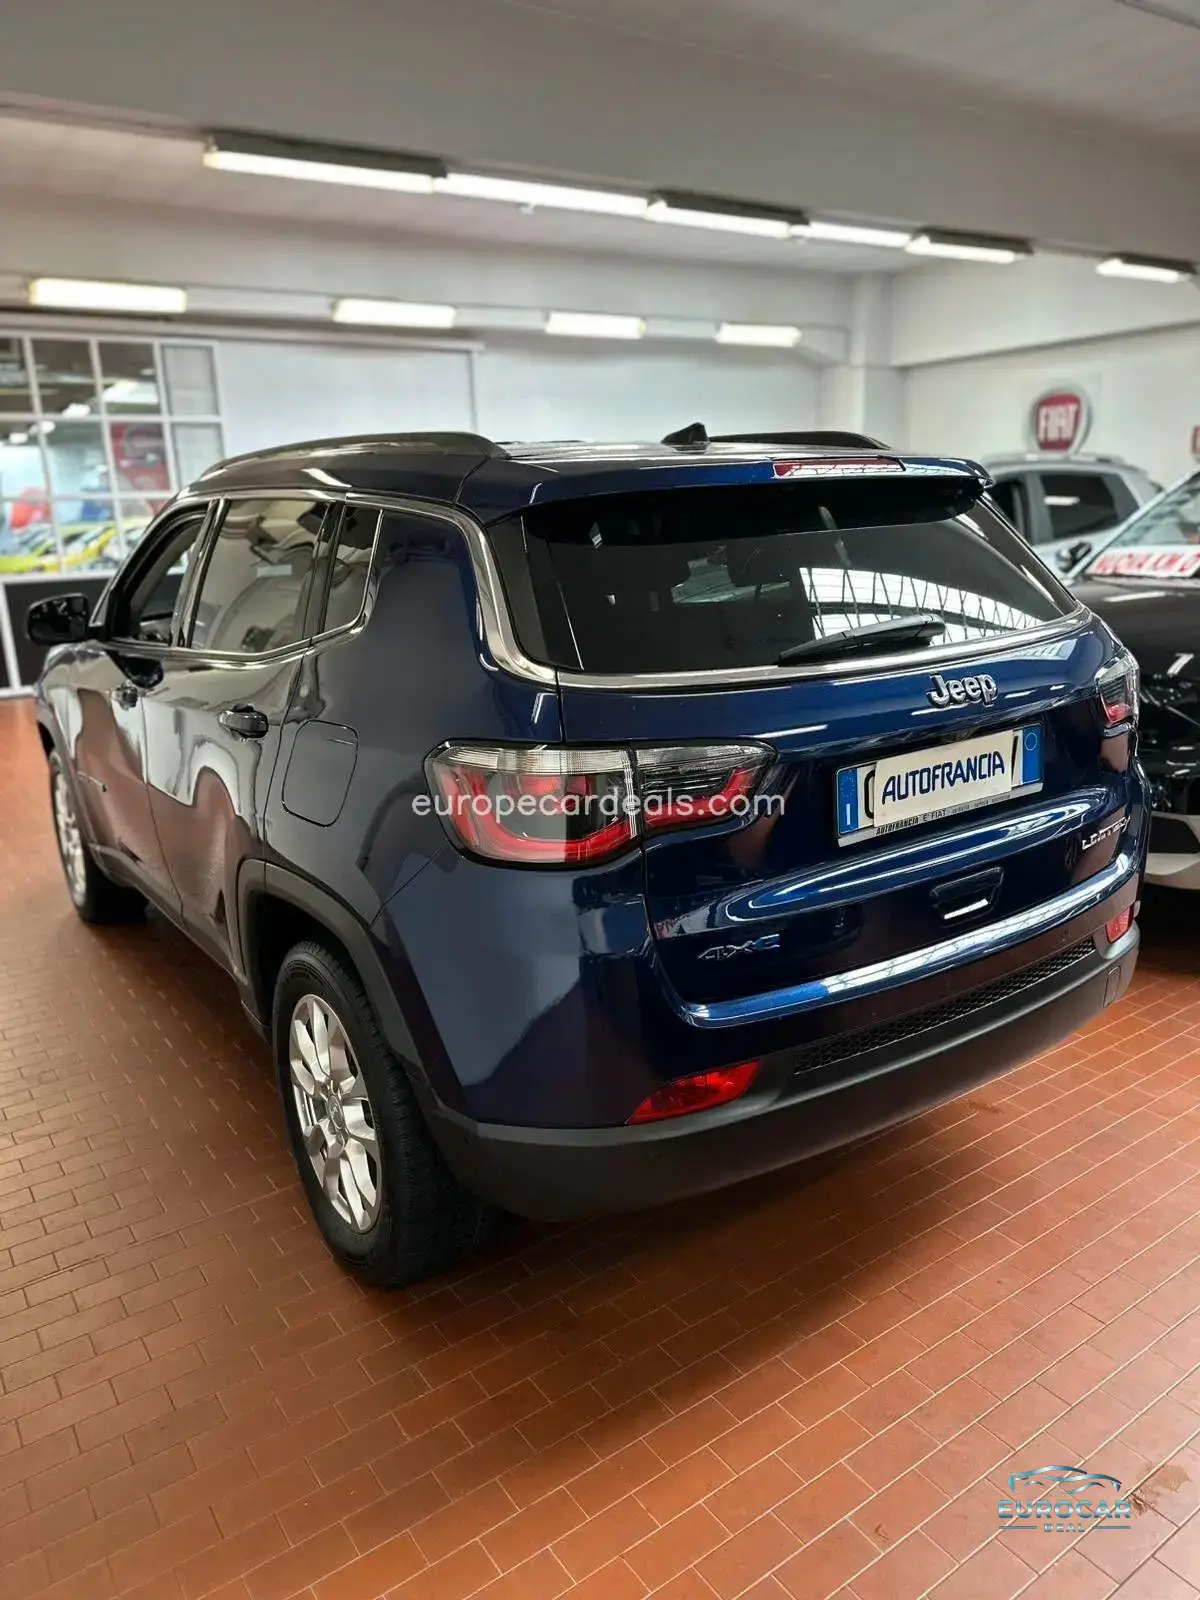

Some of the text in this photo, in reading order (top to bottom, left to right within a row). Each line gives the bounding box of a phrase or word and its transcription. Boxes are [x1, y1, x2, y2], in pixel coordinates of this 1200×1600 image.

[1038, 403, 1078, 442] FIAT
[926, 673, 998, 708] Jeep
[881, 750, 1005, 805] AUTOFRANCIA
